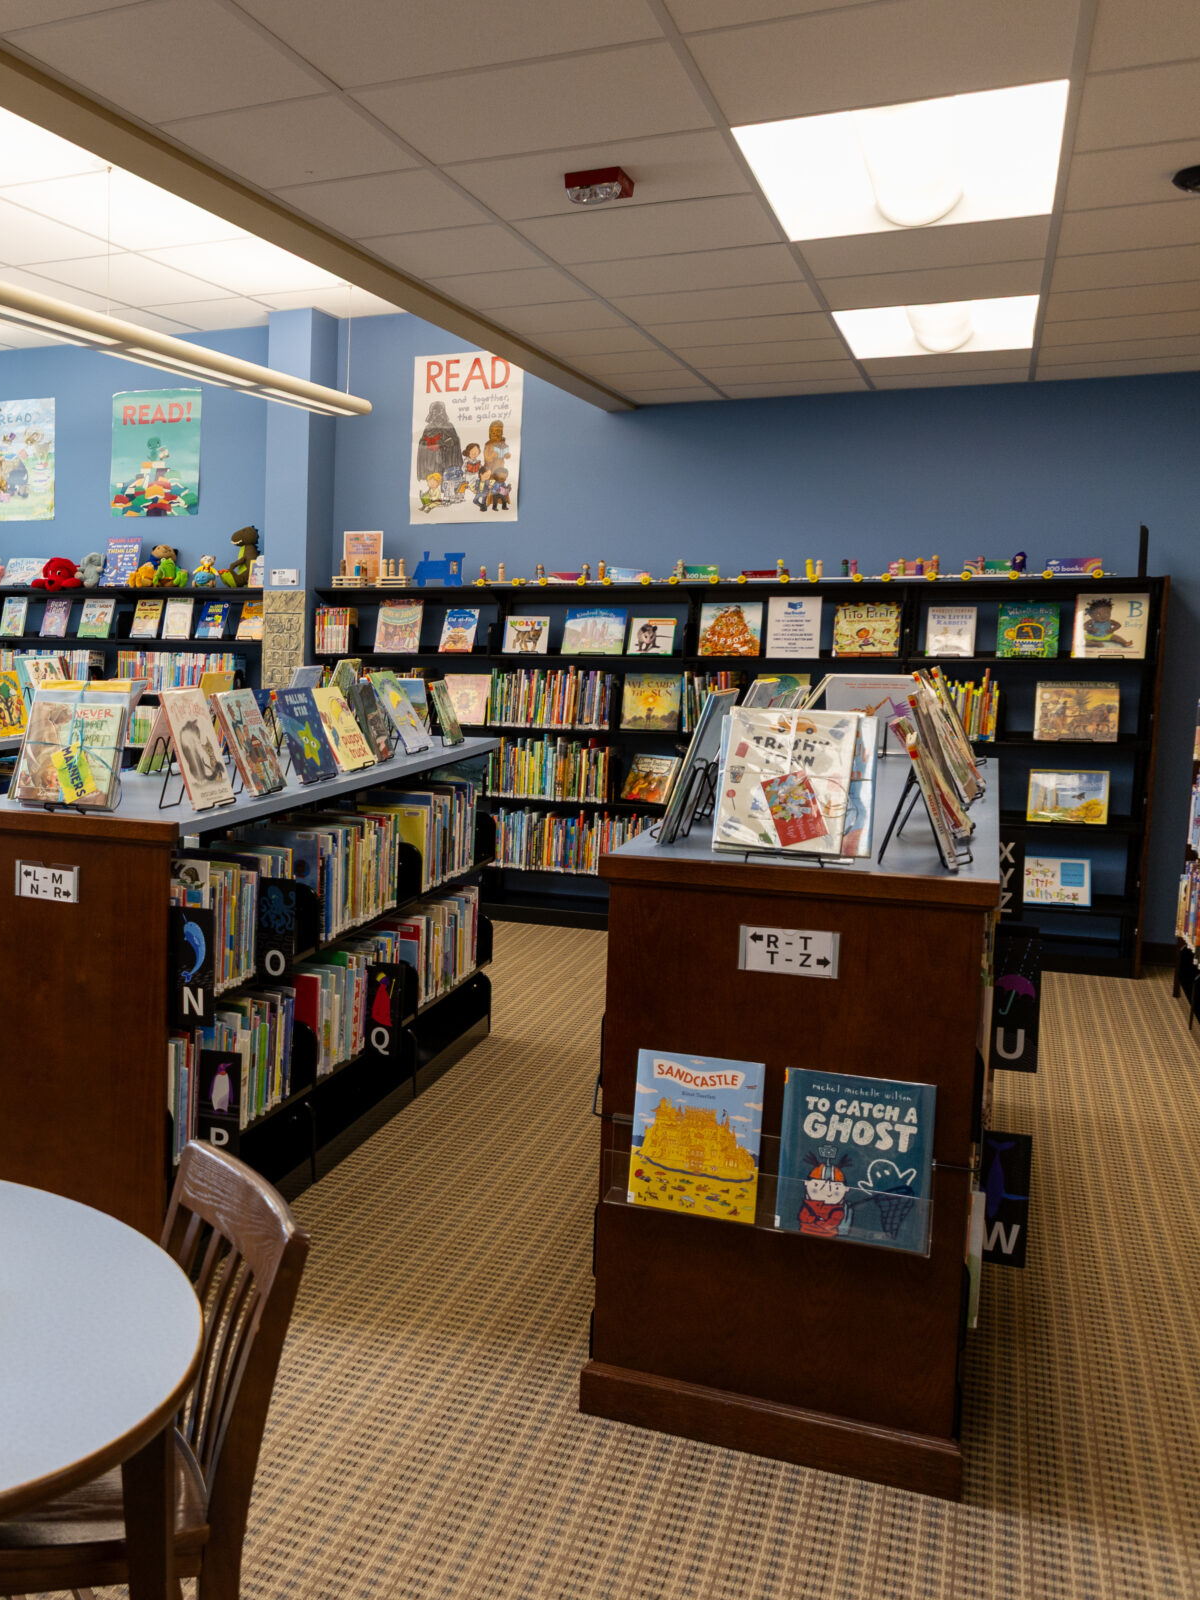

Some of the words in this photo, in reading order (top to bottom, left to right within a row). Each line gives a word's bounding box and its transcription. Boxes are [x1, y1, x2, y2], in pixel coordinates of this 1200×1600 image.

[426, 356, 511, 394] READ
[452, 396, 467, 404] and
[473, 394, 510, 404] together,
[122, 401, 192, 426] READ!
[476, 410, 512, 423] galaxy!
[722, 616, 738, 624] TOO
[1127, 601, 1144, 618] B
[706, 632, 751, 645] CARROTS
[647, 680, 678, 689] CARRY
[74, 708, 114, 720] NEVER
[341, 733, 364, 748] puppy
[349, 745, 369, 759] truck
[61, 746, 87, 797] MANNERS
[1000, 841, 1016, 864] X
[32, 870, 40, 882] L
[51, 873, 63, 885] M
[30, 883, 39, 895] N
[54, 887, 62, 899] R
[1000, 892, 1014, 913] Z
[766, 934, 779, 949] R
[799, 936, 813, 951] T
[265, 949, 286, 976] O
[766, 950, 779, 965] T
[799, 953, 812, 968] Z
[182, 986, 204, 1017] N
[370, 1025, 391, 1056] Q
[996, 1026, 1026, 1061] U
[657, 1063, 741, 1088] SANDCASTLE
[811, 1082, 841, 1093] rachel
[844, 1086, 881, 1098] michelle
[884, 1090, 913, 1103] wilson
[805, 1095, 827, 1112] TO
[835, 1100, 900, 1121] CATCH
[904, 1106, 919, 1125] A
[803, 1111, 919, 1153] GHOST
[982, 1221, 1021, 1255] W
